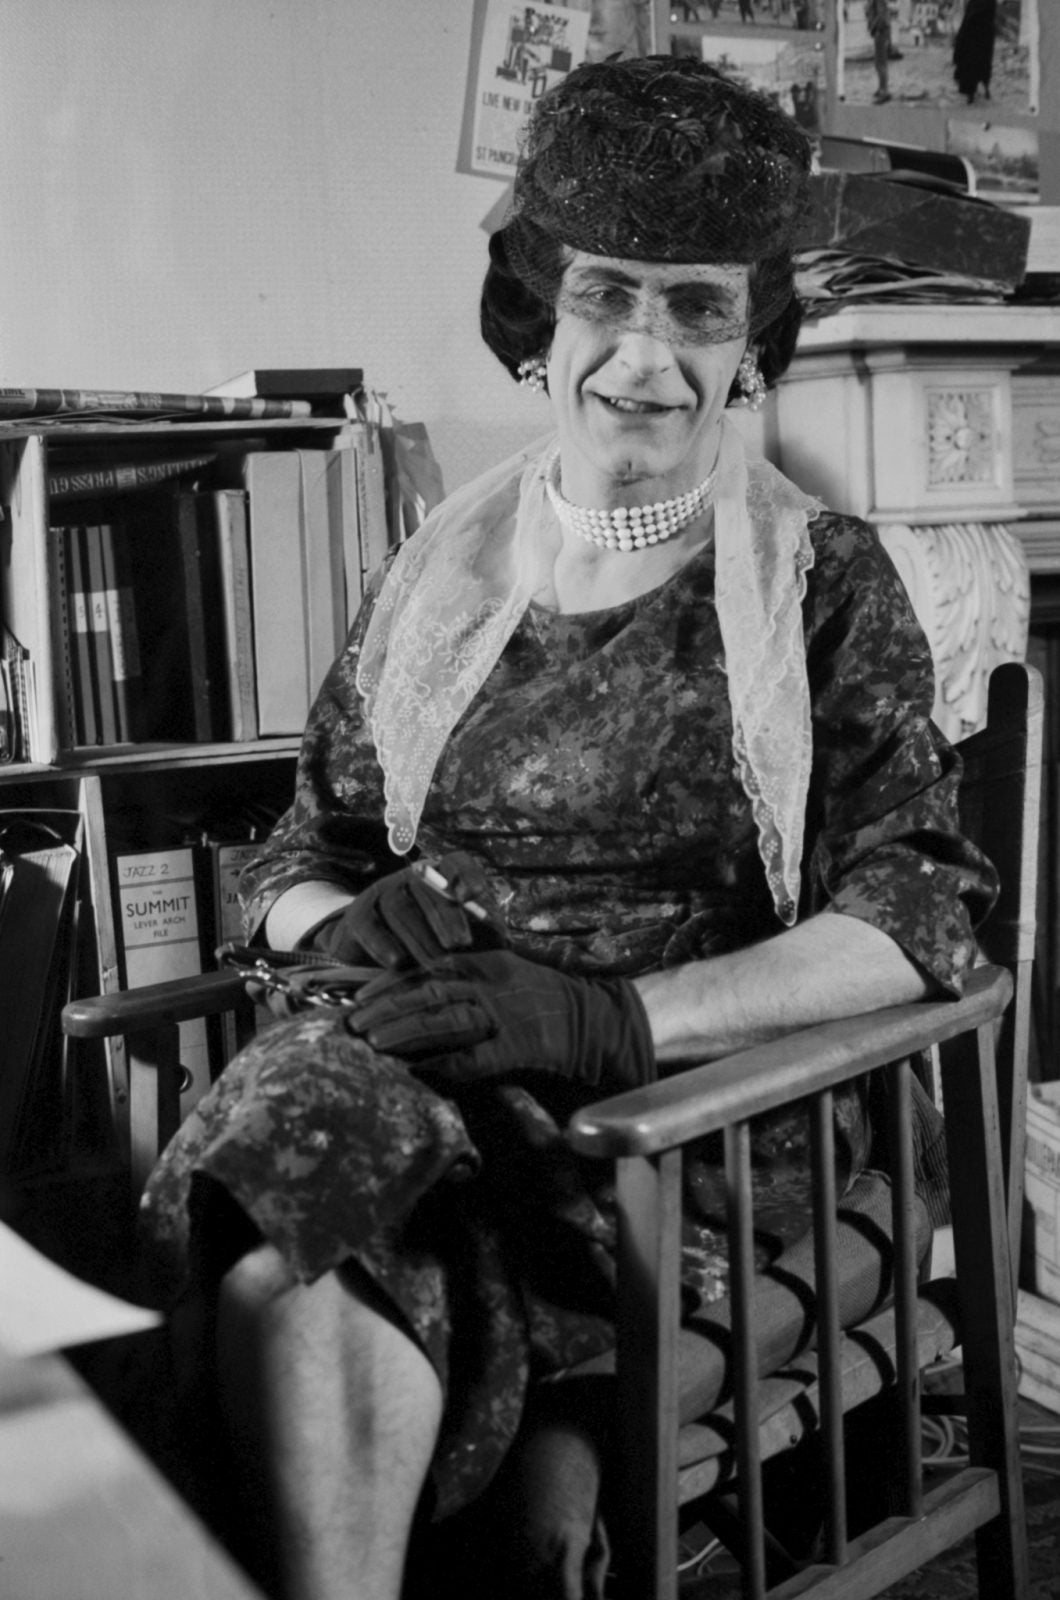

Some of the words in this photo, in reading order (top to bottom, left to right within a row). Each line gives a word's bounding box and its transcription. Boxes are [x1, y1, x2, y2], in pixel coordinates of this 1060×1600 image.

[482, 91, 499, 108] LIVE
[502, 95, 520, 112] NEW
[523, 99, 534, 114] DE
[49, 477, 69, 494] GU
[71, 471, 114, 492] PRESS
[123, 864, 155, 878] JAZZ
[160, 863, 170, 875] 2
[226, 892, 239, 904] JA
[126, 895, 191, 918] SUMMIT
[134, 919, 158, 930] LEVER
[162, 916, 187, 925] ARCH
[153, 928, 169, 938] FILE
